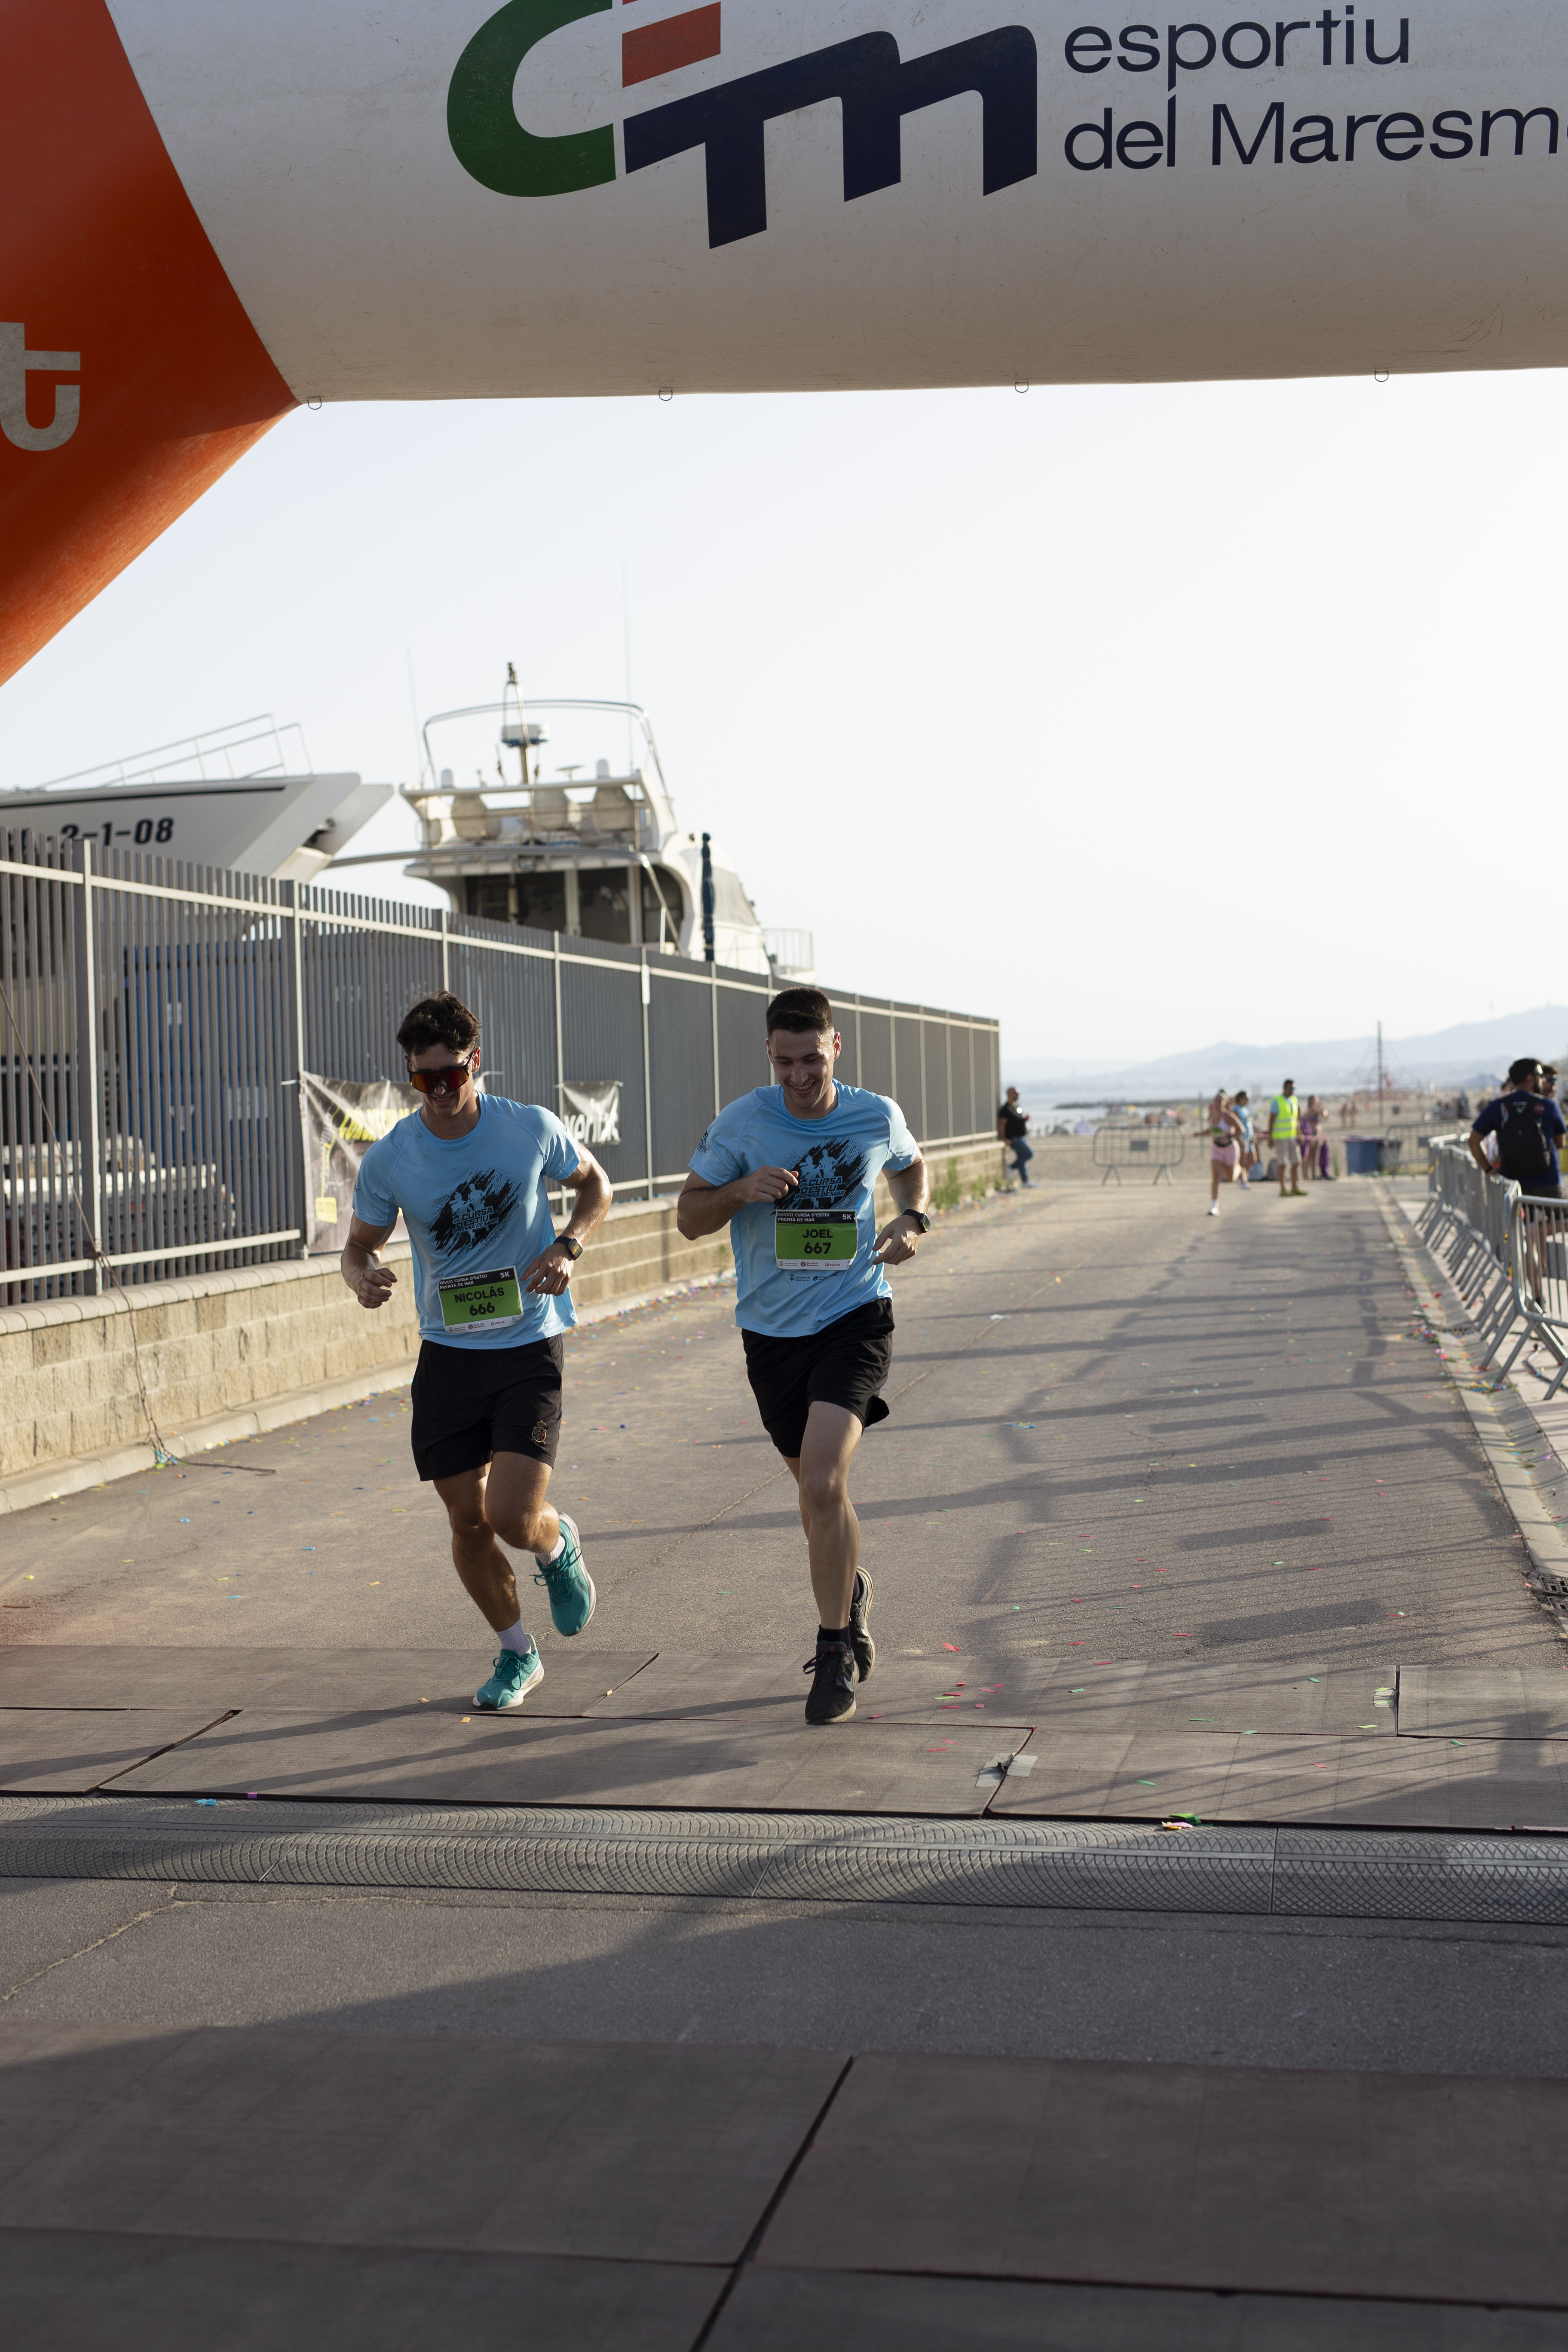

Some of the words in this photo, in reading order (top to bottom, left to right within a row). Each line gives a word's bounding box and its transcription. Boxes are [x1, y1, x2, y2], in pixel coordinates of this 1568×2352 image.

[1064, 5, 1409, 92] esportiu
[1064, 94, 1176, 171] del
[1212, 101, 1568, 167] Maresm
[808, 1177, 842, 1186] CURSA
[800, 1184, 837, 1194] D'ESTIU
[456, 1214, 490, 1228] D'ESTIU
[462, 1207, 493, 1221] CURSA
[484, 1218, 499, 1226] MAR
[802, 1229, 833, 1238] JOEL
[804, 1242, 831, 1254] 667
[454, 1286, 505, 1303] NICOLÁS
[469, 1302, 496, 1316] 666
